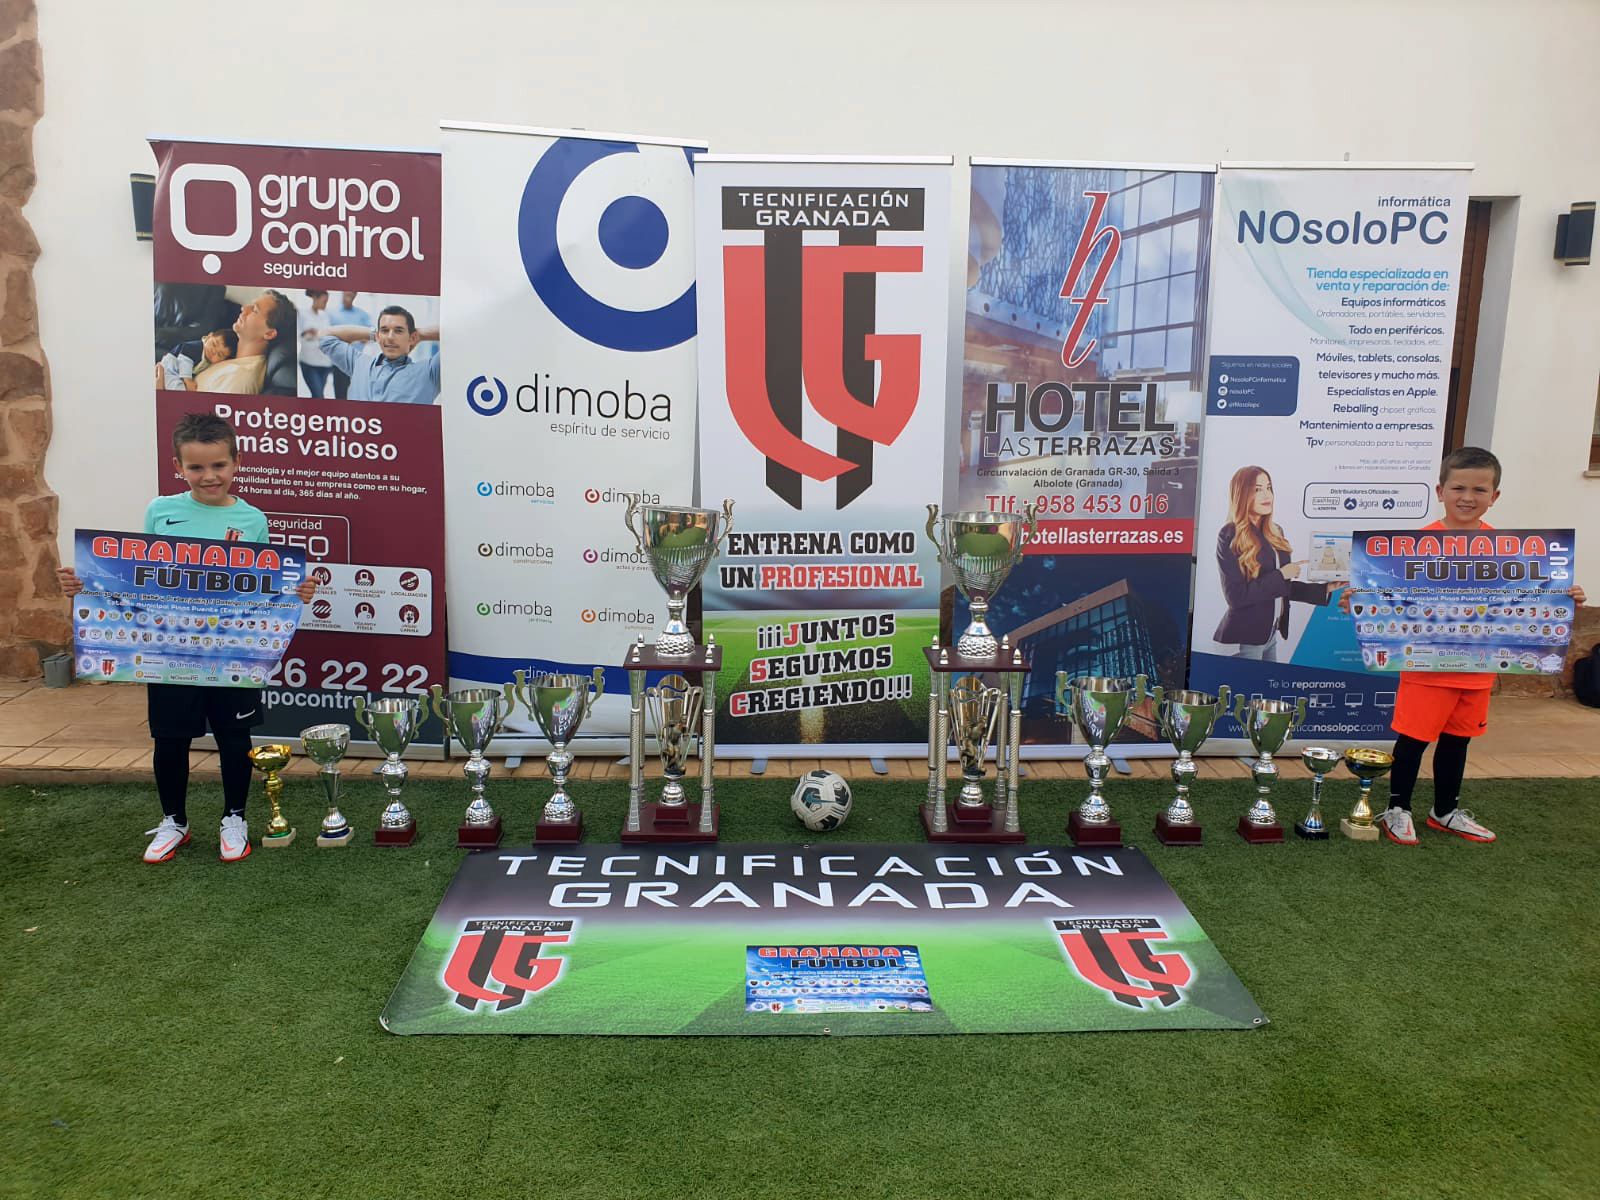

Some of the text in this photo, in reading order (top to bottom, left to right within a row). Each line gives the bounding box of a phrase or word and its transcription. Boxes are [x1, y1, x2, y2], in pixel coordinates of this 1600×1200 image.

[259, 173, 400, 221] grupo
[738, 190, 910, 208] TECNIFICACIÓN
[1377, 196, 1451, 208] informática
[756, 209, 890, 227] GRANADA
[1237, 210, 1449, 245] NOsoloPC
[261, 216, 424, 261] control
[263, 261, 347, 279] seguridad
[1306, 267, 1449, 281] Tienda especializada en
[1316, 281, 1450, 293] venta y reparación de:
[1341, 297, 1381, 308] Equipos
[1349, 325, 1445, 337] Todo en periféricos.
[1316, 353, 1356, 363] Móviles,
[1358, 353, 1395, 363] tablets,
[1318, 370, 1440, 381] televisores y mucho más.
[516, 373, 672, 422] dimoba
[1327, 387, 1390, 398] Especialistas
[1406, 387, 1438, 399] Apple.
[985, 382, 1175, 434] HOTEL
[1333, 404, 1379, 417] Reballing
[215, 404, 382, 436] Protegemos
[1299, 420, 1374, 430] Mantenimiento
[550, 421, 670, 441] espíritu de servicio
[235, 432, 398, 461] más valioso
[1306, 437, 1324, 448] Tpv
[1325, 439, 1375, 448] personalizado
[1376, 440, 1395, 448] para
[281, 469, 286, 477] y
[296, 470, 320, 479] mejor
[321, 471, 349, 479] equipo
[351, 472, 381, 480] atentos
[976, 467, 1180, 478] Circunvalación de Granada GR-30, Salida 3
[250, 487, 273, 495] horas
[271, 477, 293, 485] tanto
[317, 482, 352, 491] empresa
[353, 483, 376, 491] como
[401, 485, 428, 495] hogar,
[495, 481, 555, 498] dimoba
[1033, 479, 1123, 490] Albolote (Granada)
[1036, 495, 1075, 514] 958
[1083, 494, 1122, 514] 453
[1129, 494, 1169, 514] 016
[268, 519, 323, 531] seguridad
[495, 542, 554, 558] dimoba
[727, 531, 916, 556] ENTRENA COMO
[1366, 535, 1547, 557] GRANADA
[92, 537, 281, 570] GRANADA
[1550, 541, 1569, 580] CUP
[282, 557, 301, 595] CUP
[720, 564, 923, 589] UN PROFESIONAL
[1404, 557, 1550, 581] FÚTBOL
[135, 564, 281, 596] FÚTBOL
[492, 600, 552, 616] dimoba
[598, 608, 655, 624] dimoba
[751, 645, 893, 683] SEGUIMOS
[320, 660, 368, 692] 22
[382, 663, 430, 695] 22
[1268, 679, 1346, 690] Te lo reparamos
[730, 674, 913, 717] CRECIENDO!!!
[498, 851, 1124, 877] TECNIFICACIÓN
[548, 881, 1074, 909] GRANADA
[758, 947, 901, 958] GRANADA
[902, 949, 921, 968] CUP
[791, 956, 906, 969] FÚTBOL
